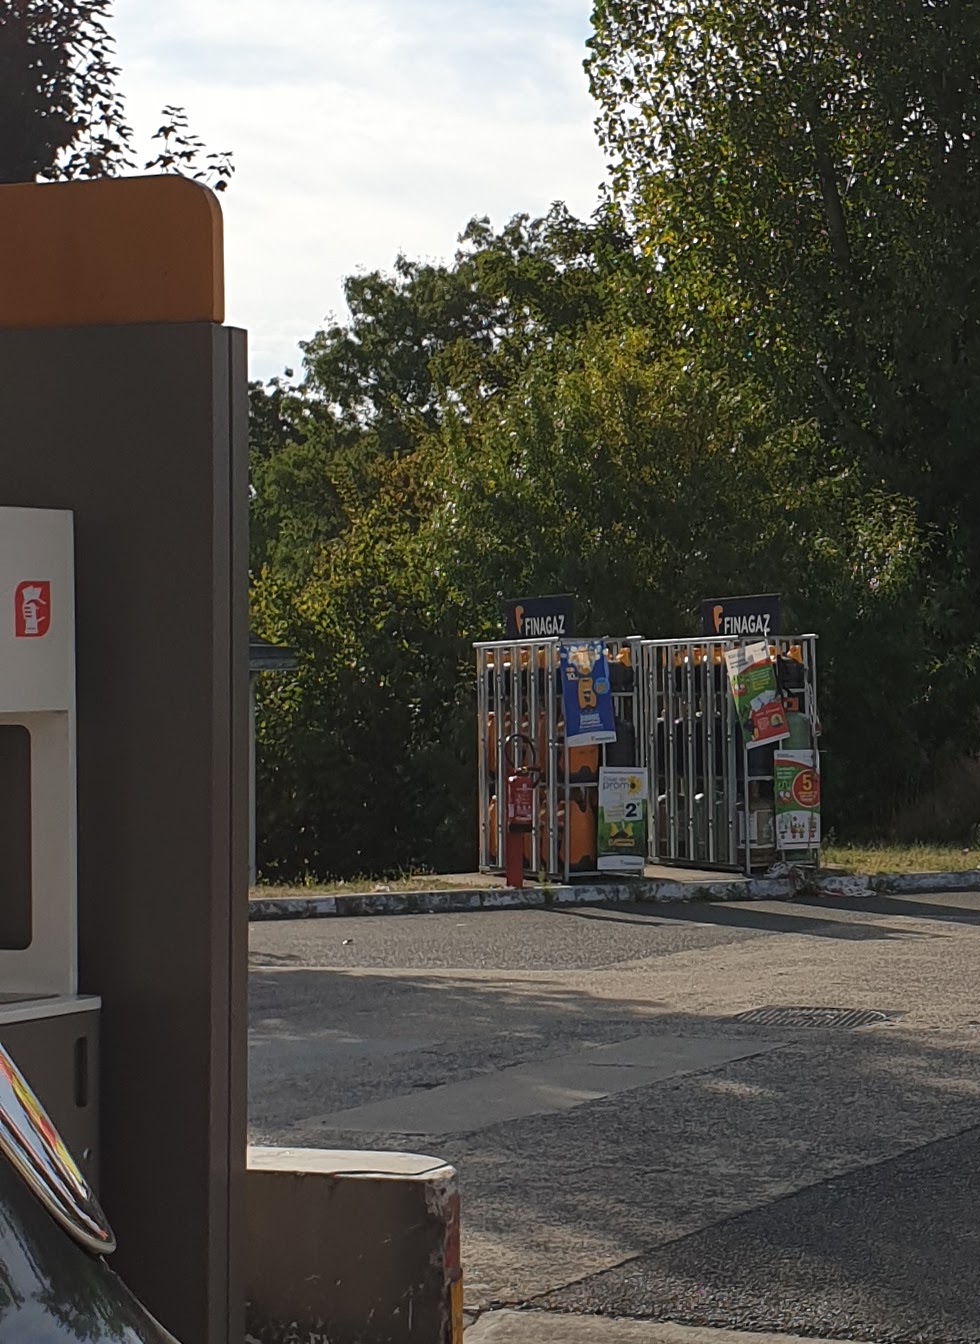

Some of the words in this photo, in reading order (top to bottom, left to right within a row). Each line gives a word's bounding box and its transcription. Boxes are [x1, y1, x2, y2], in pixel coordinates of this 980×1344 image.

[525, 614, 566, 636] FINAGAZ
[724, 613, 771, 635] FINAGAZ
[802, 774, 813, 791] 5
